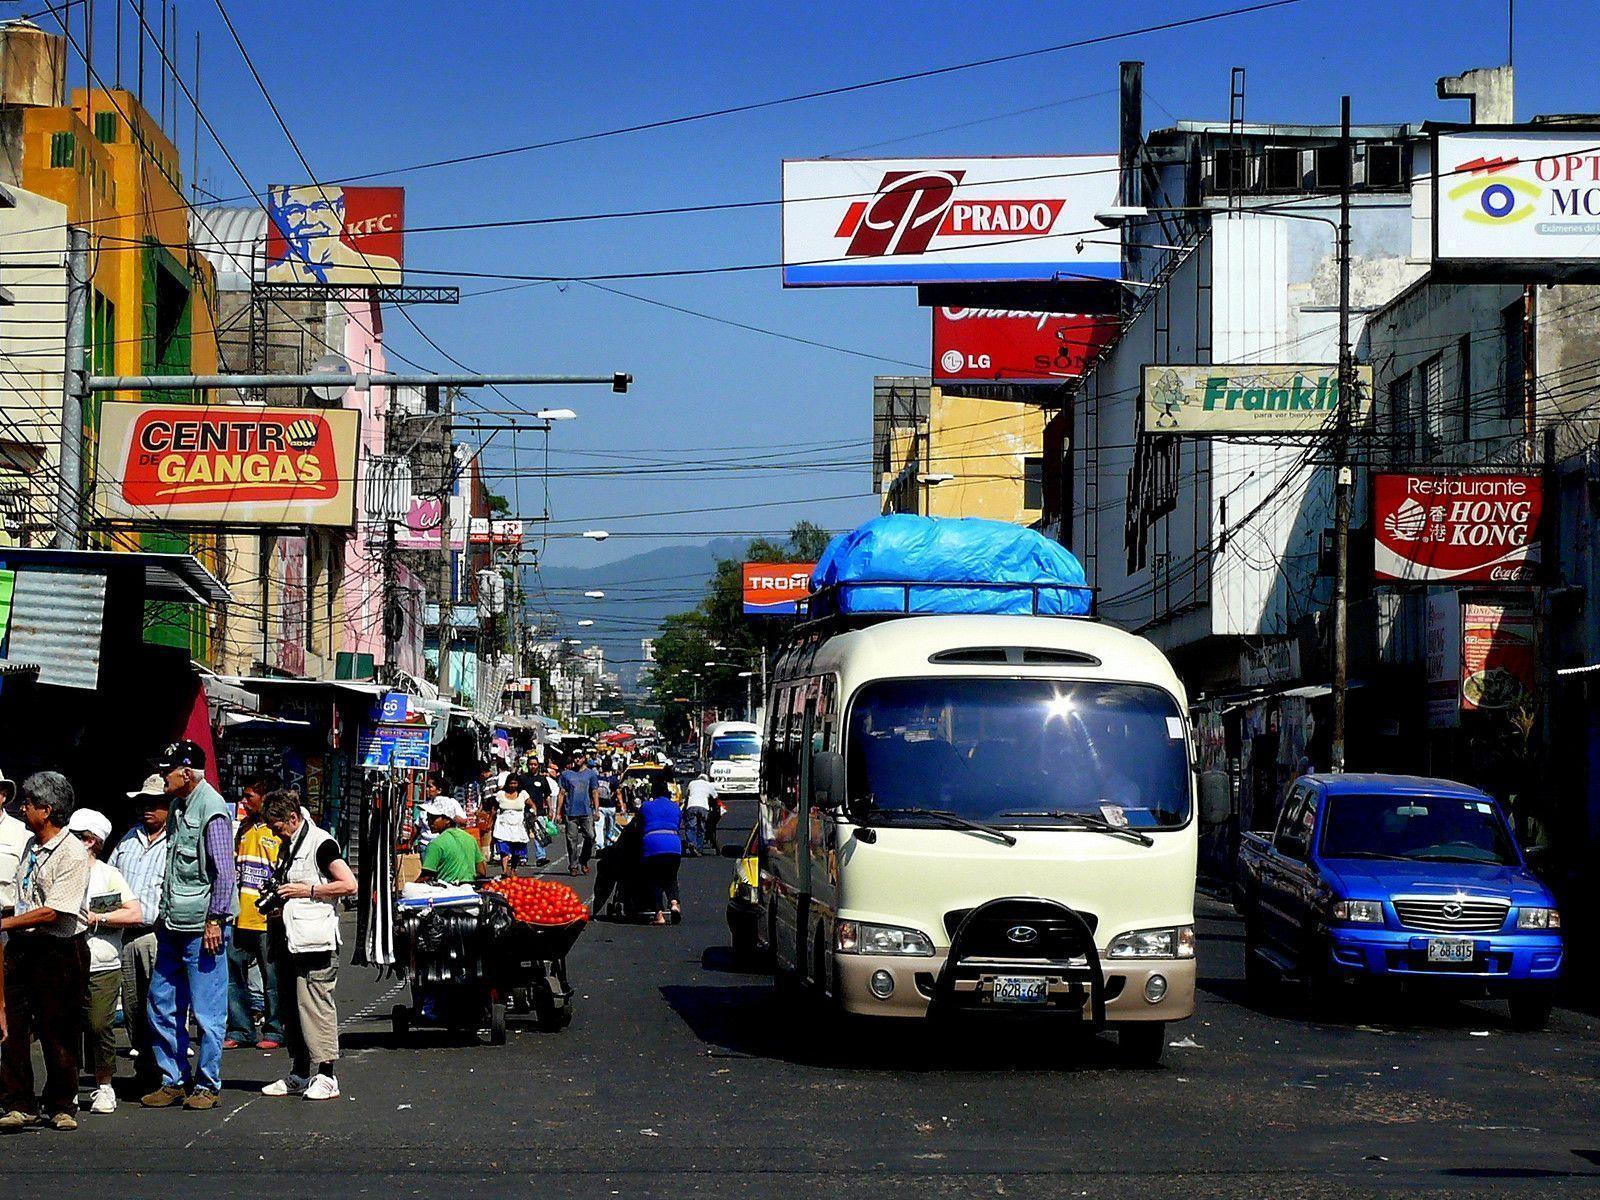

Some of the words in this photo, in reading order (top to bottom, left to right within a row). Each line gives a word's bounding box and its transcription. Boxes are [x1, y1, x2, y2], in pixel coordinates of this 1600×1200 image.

[346, 214, 393, 241] KFC
[952, 202, 1052, 231] PRADO
[967, 354, 991, 369] LG
[1034, 353, 1099, 369] SON
[1202, 376, 1340, 411] Frankli
[139, 454, 160, 465] DE
[157, 454, 322, 484] GANGAS
[1407, 477, 1527, 496] Restaurante
[1448, 501, 1532, 523] HONG
[1448, 523, 1528, 547] KONG
[748, 572, 809, 591] TROPI
